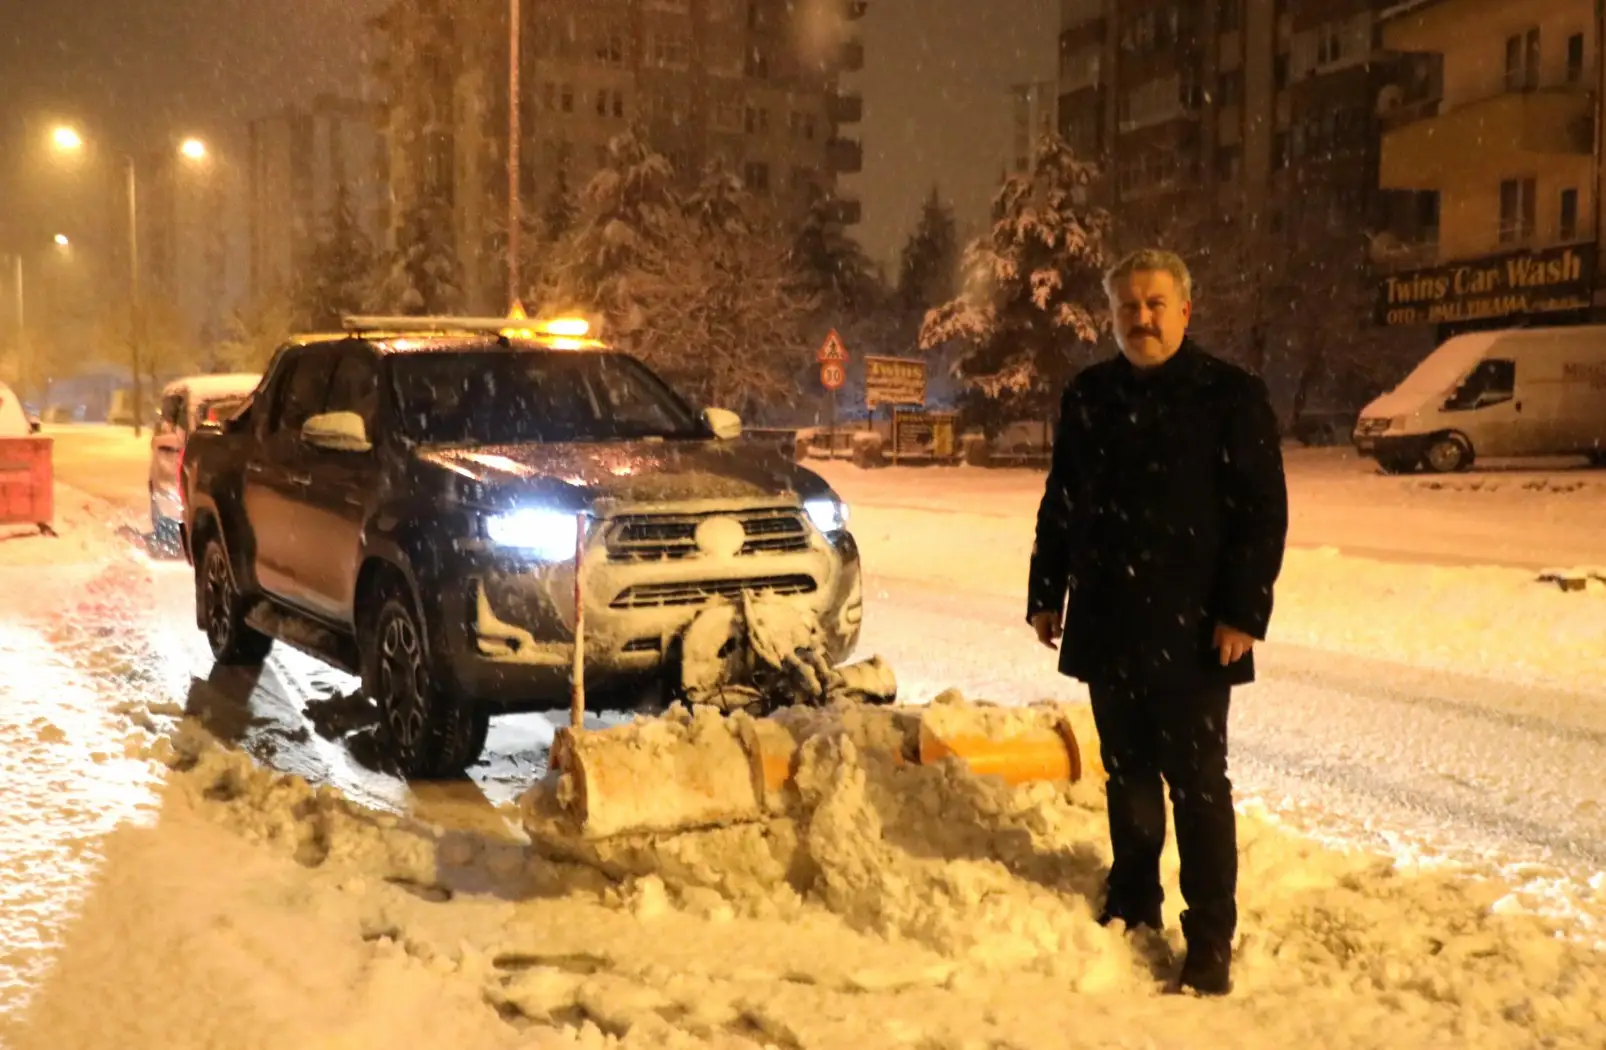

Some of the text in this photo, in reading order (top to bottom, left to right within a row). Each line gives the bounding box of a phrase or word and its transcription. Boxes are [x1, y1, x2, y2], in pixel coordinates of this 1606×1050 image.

[1386, 250, 1582, 303] Twins Car Wash
[1387, 307, 1416, 324] OTO
